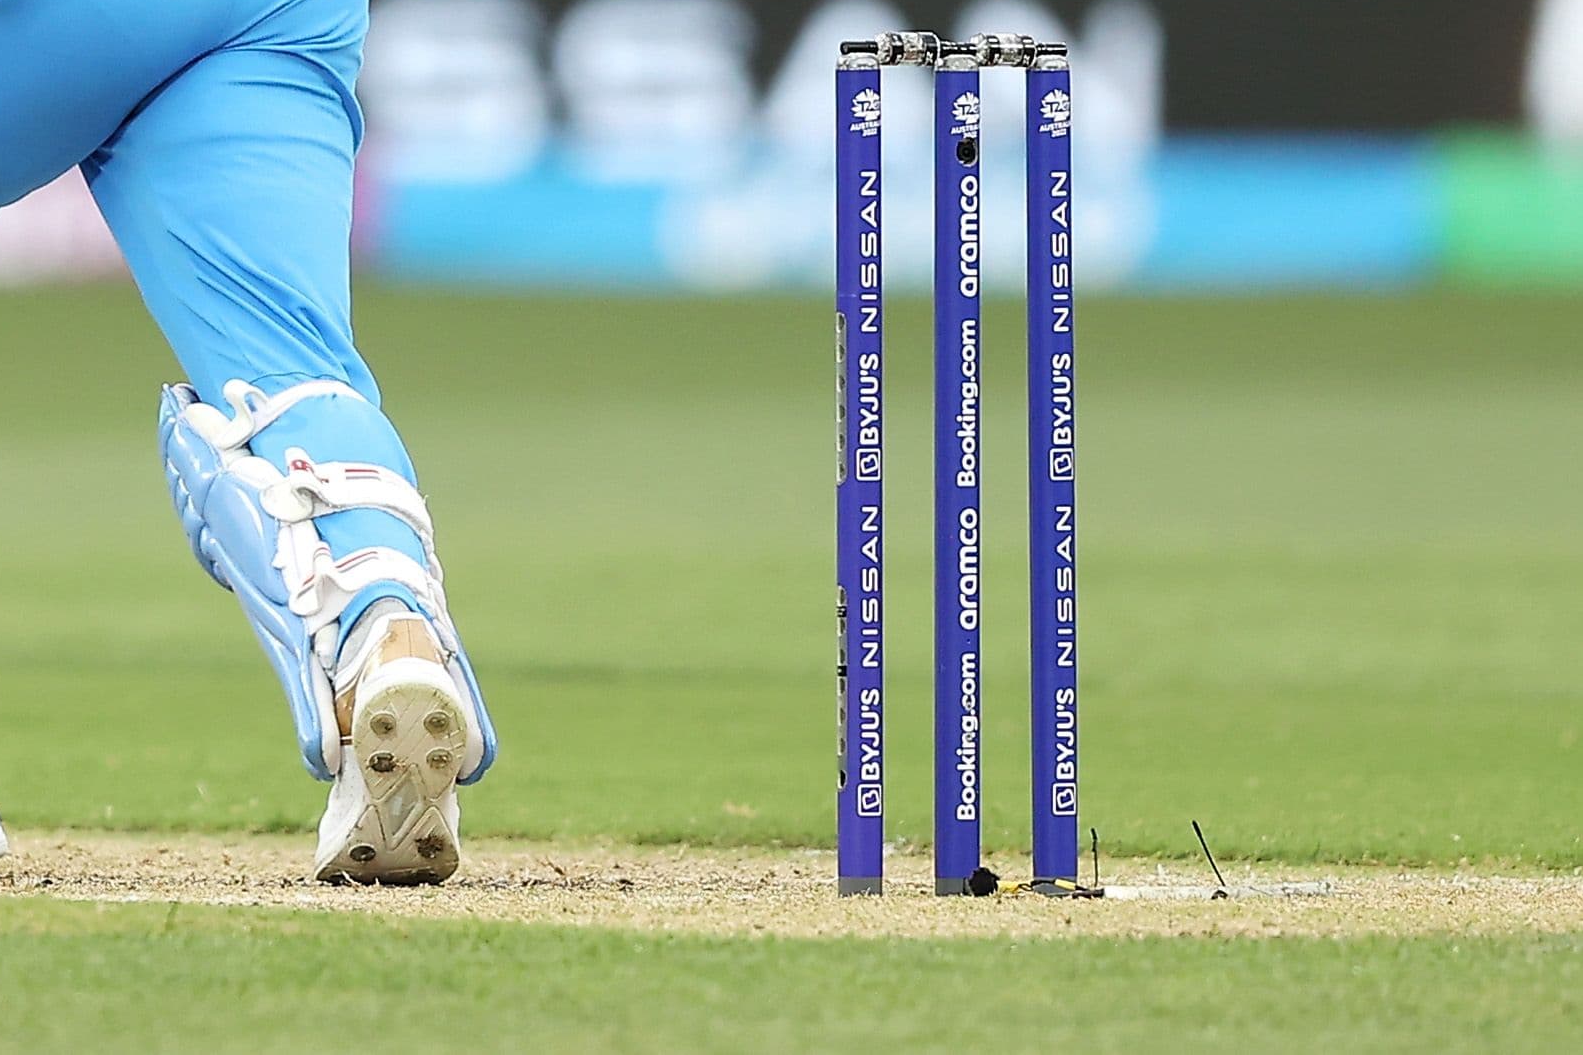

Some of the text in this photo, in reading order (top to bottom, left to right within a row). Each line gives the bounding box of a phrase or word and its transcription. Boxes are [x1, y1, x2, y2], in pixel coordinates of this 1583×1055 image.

[861, 171, 878, 332] NISSAN
[956, 175, 978, 487] Booking.com aramco
[1051, 171, 1069, 332] NISSAN
[860, 353, 879, 445] BYJU'S
[1052, 353, 1071, 445] BYJU'S
[862, 506, 879, 667] NISSAN
[956, 508, 979, 820] Booking.com aramco
[1056, 506, 1073, 666] NISSAN
[860, 688, 880, 781] BYJU'S
[1056, 688, 1074, 780] BYJU'S
